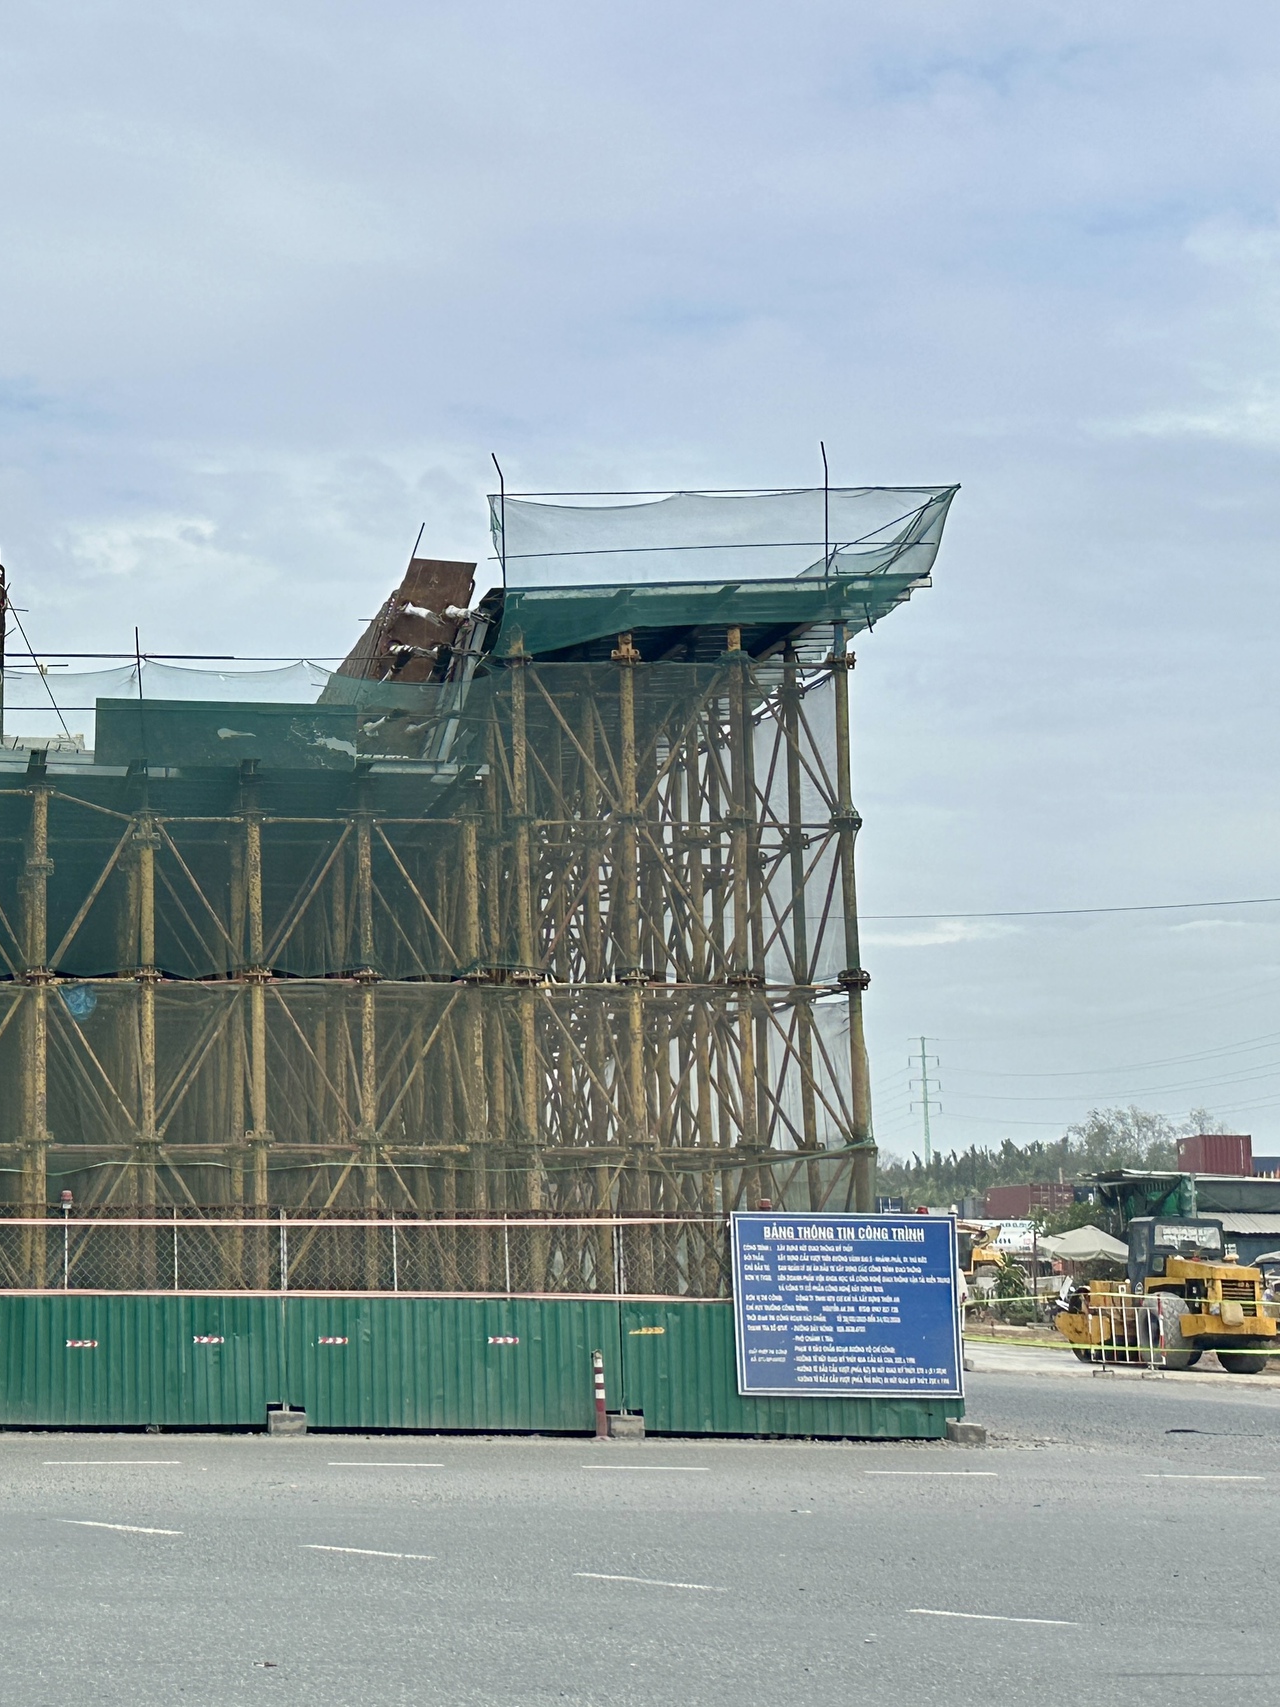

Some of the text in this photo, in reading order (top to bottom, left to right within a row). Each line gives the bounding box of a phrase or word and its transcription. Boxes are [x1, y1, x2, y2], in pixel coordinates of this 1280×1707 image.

[763, 1222, 925, 1242] BẢNG THÔNG TIN CÔNG TRÌNH
